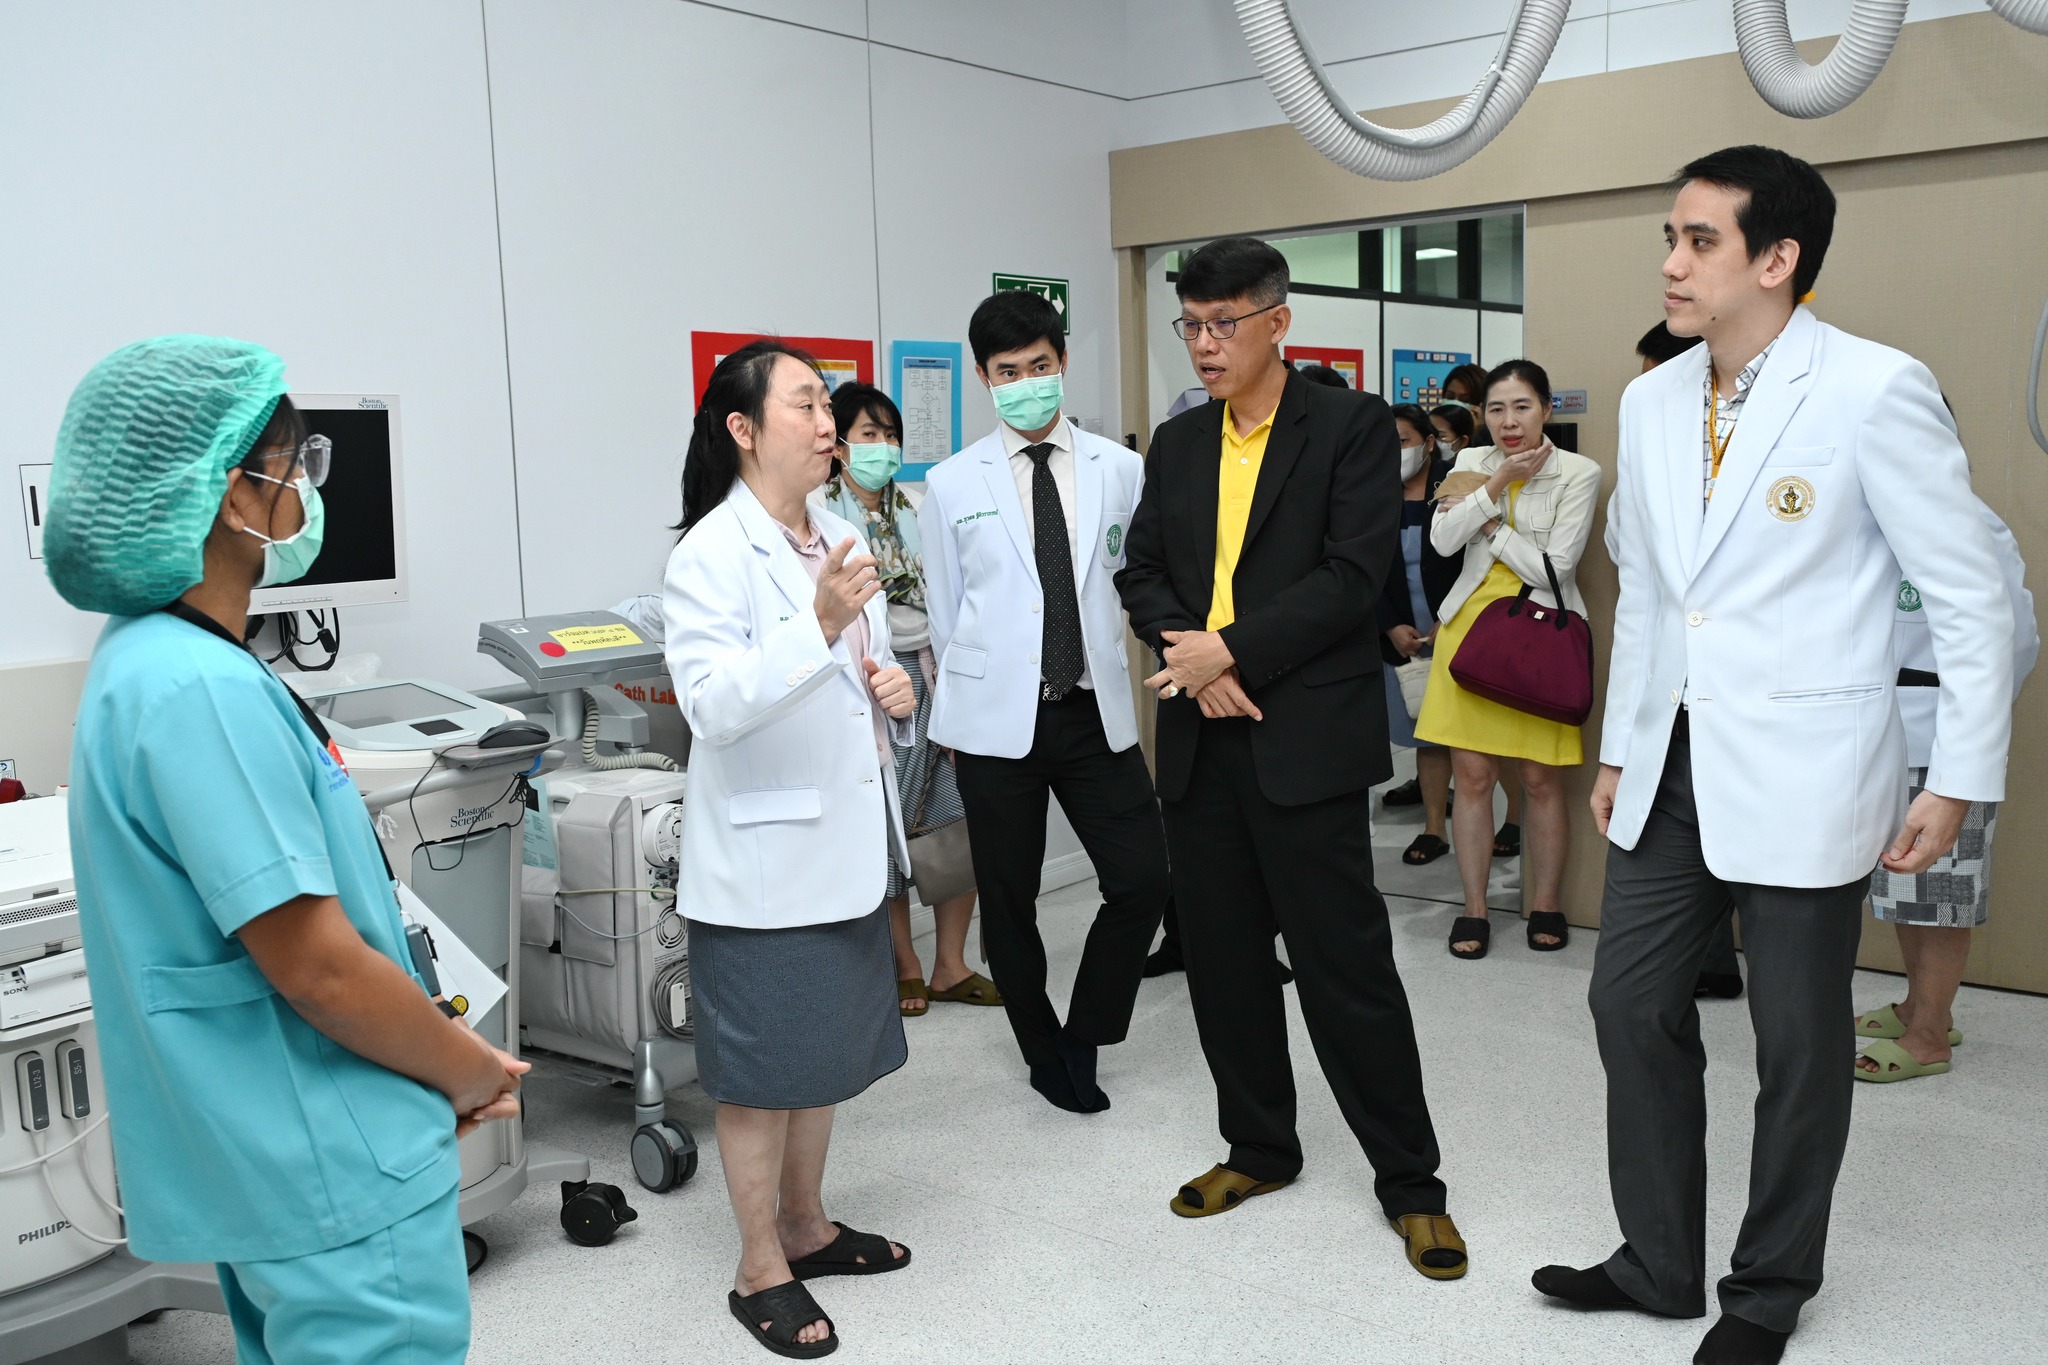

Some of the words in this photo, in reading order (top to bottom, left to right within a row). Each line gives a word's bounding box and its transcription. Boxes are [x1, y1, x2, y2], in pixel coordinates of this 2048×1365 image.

[650, 686, 677, 705] Lab
[450, 810, 495, 828] Scientific
[458, 806, 486, 818] Boston
[3, 986, 29, 996] SONY
[33, 1069, 42, 1089] L12-3
[18, 1219, 72, 1245] PHILIPS
